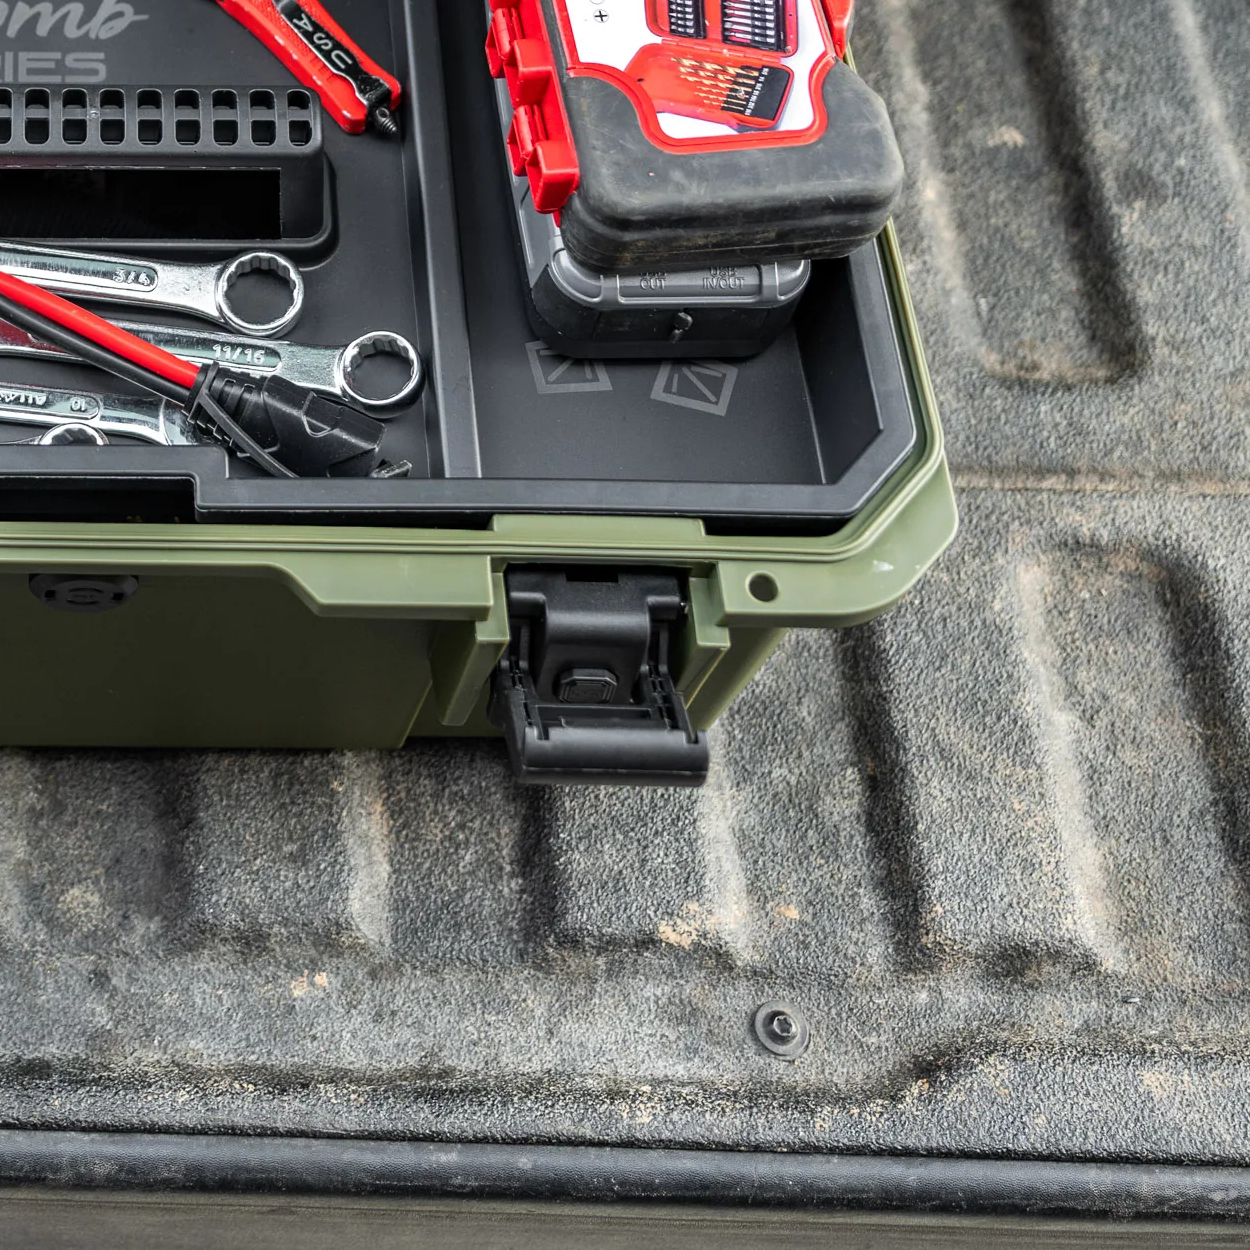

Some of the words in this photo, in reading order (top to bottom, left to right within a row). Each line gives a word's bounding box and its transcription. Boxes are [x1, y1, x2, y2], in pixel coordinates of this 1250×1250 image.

[292, 12, 353, 69] USA
[639, 277, 666, 291] OUT
[702, 276, 745, 290] IN/OUT
[212, 343, 266, 365] 11/16
